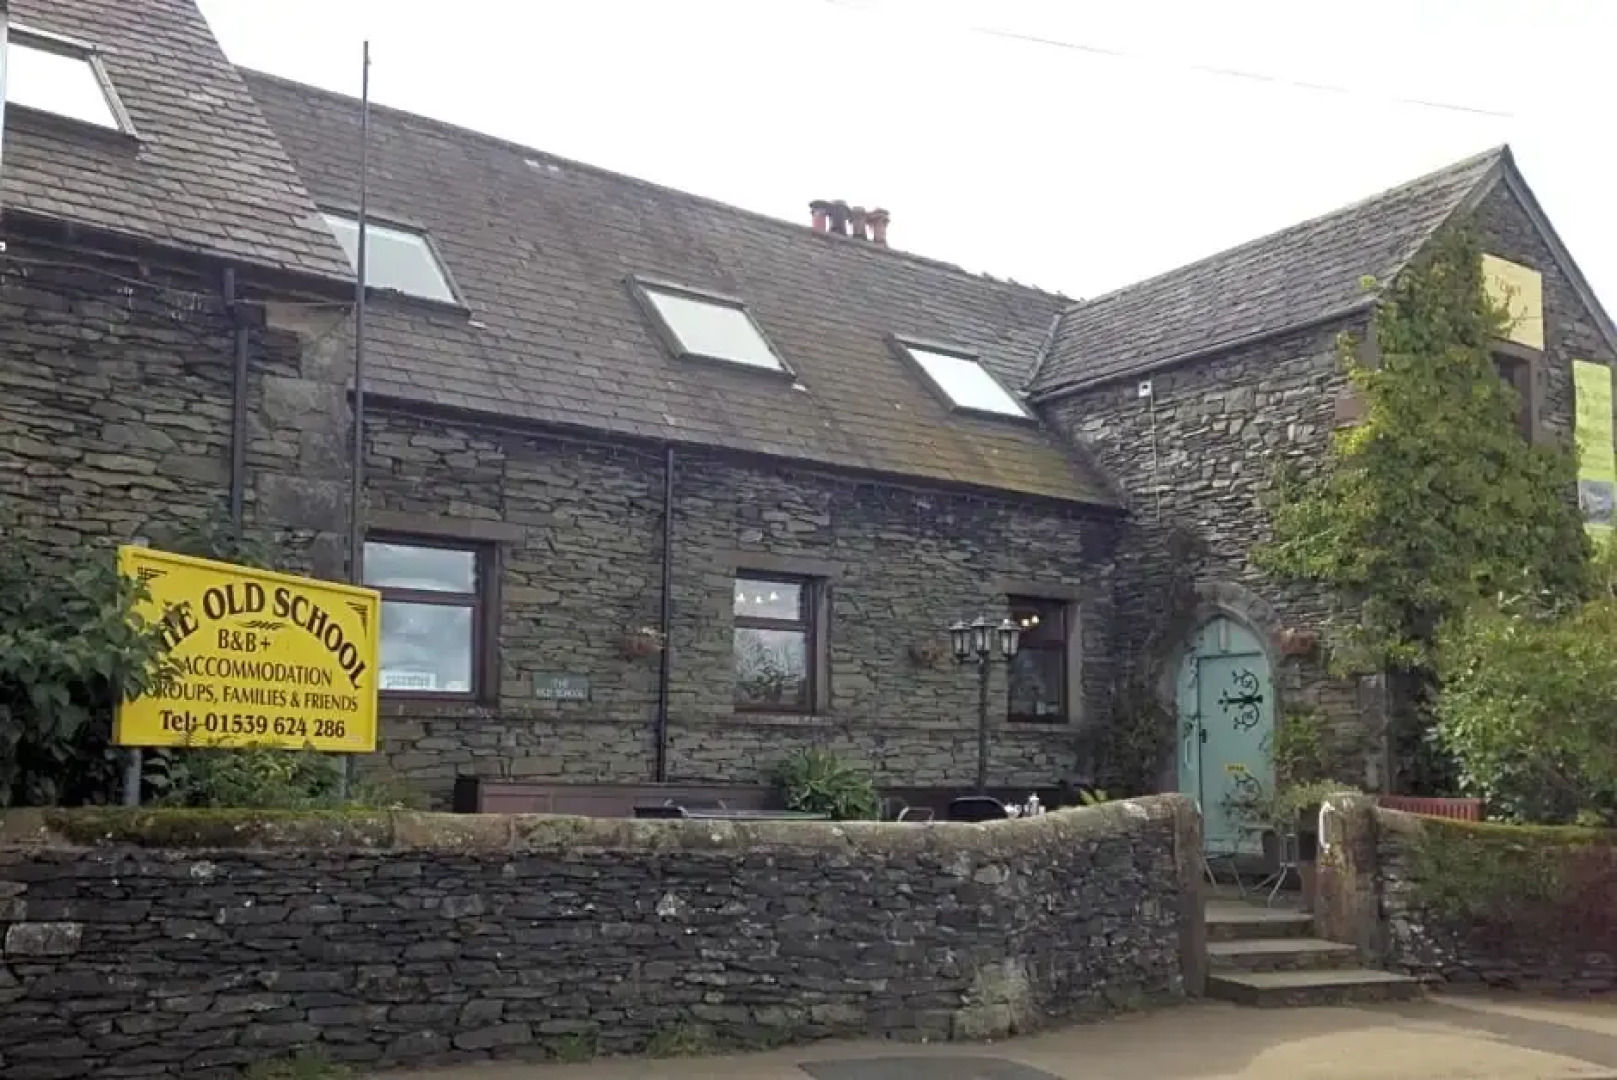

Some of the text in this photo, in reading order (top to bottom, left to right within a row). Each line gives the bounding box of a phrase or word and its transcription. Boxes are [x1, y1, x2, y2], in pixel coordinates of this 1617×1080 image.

[203, 582, 266, 620] OLD
[273, 587, 366, 690] SCHOOL
[183, 655, 333, 687] ACCOMMODATION
[223, 685, 288, 707] FAMILIES
[290, 690, 300, 708] &
[304, 693, 359, 713] FRIENDS
[205, 712, 267, 735] 01539
[274, 715, 306, 737] 624
[313, 718, 345, 738] 286
